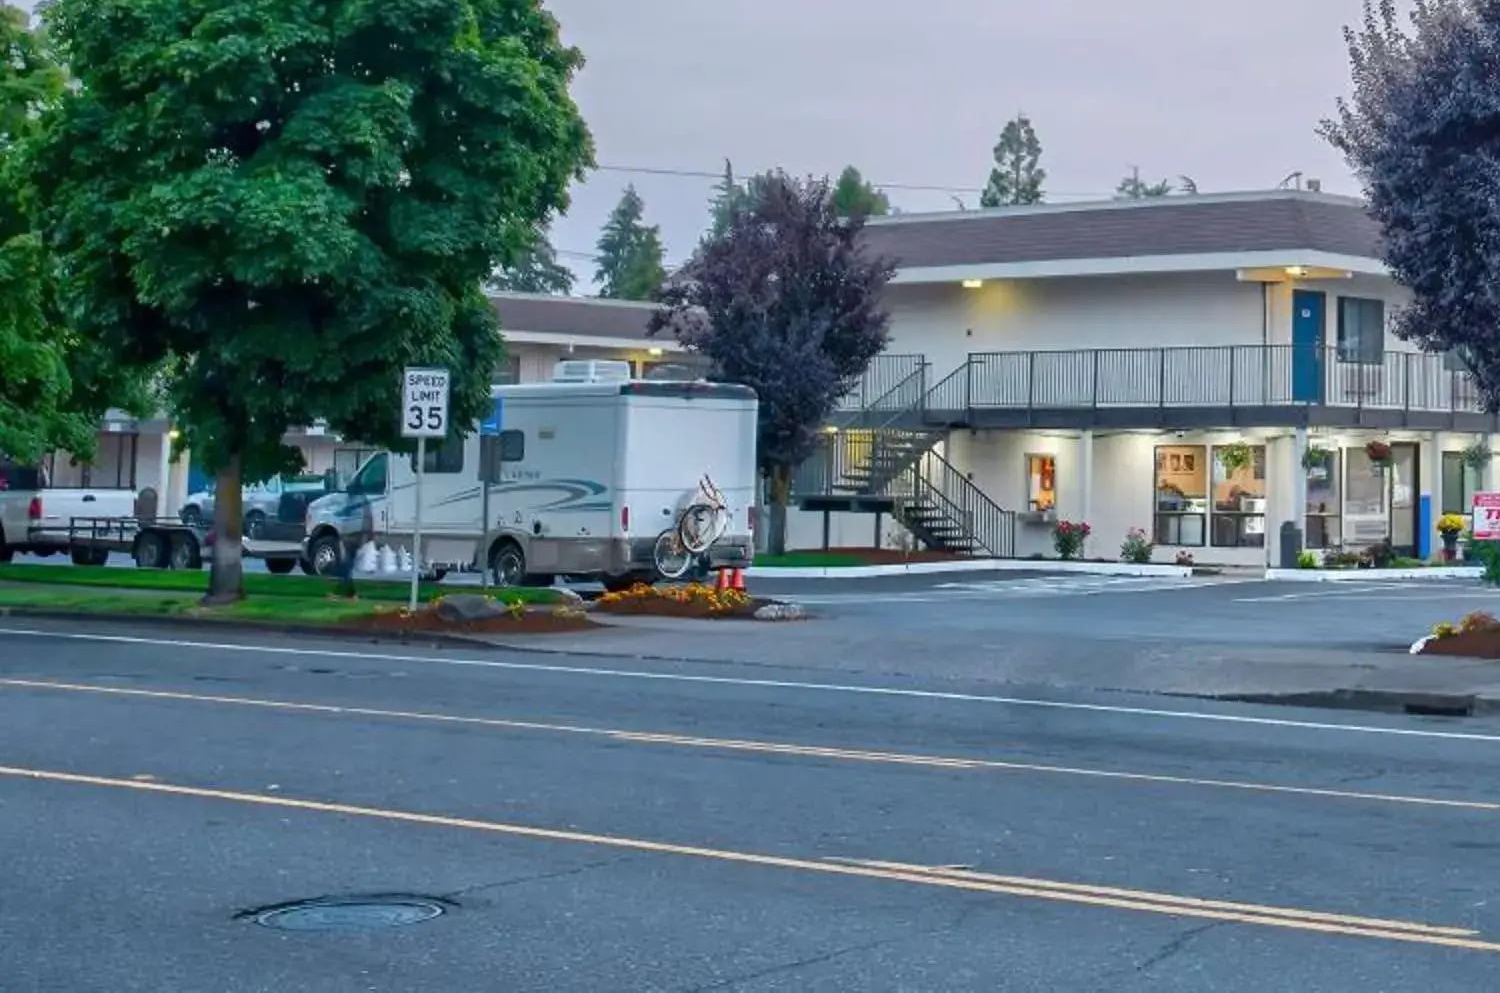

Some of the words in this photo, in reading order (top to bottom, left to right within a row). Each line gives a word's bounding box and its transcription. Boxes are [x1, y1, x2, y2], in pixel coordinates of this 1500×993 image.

[408, 374, 446, 386] SPEED
[411, 391, 441, 403] LIMIT
[407, 405, 443, 430] 35
